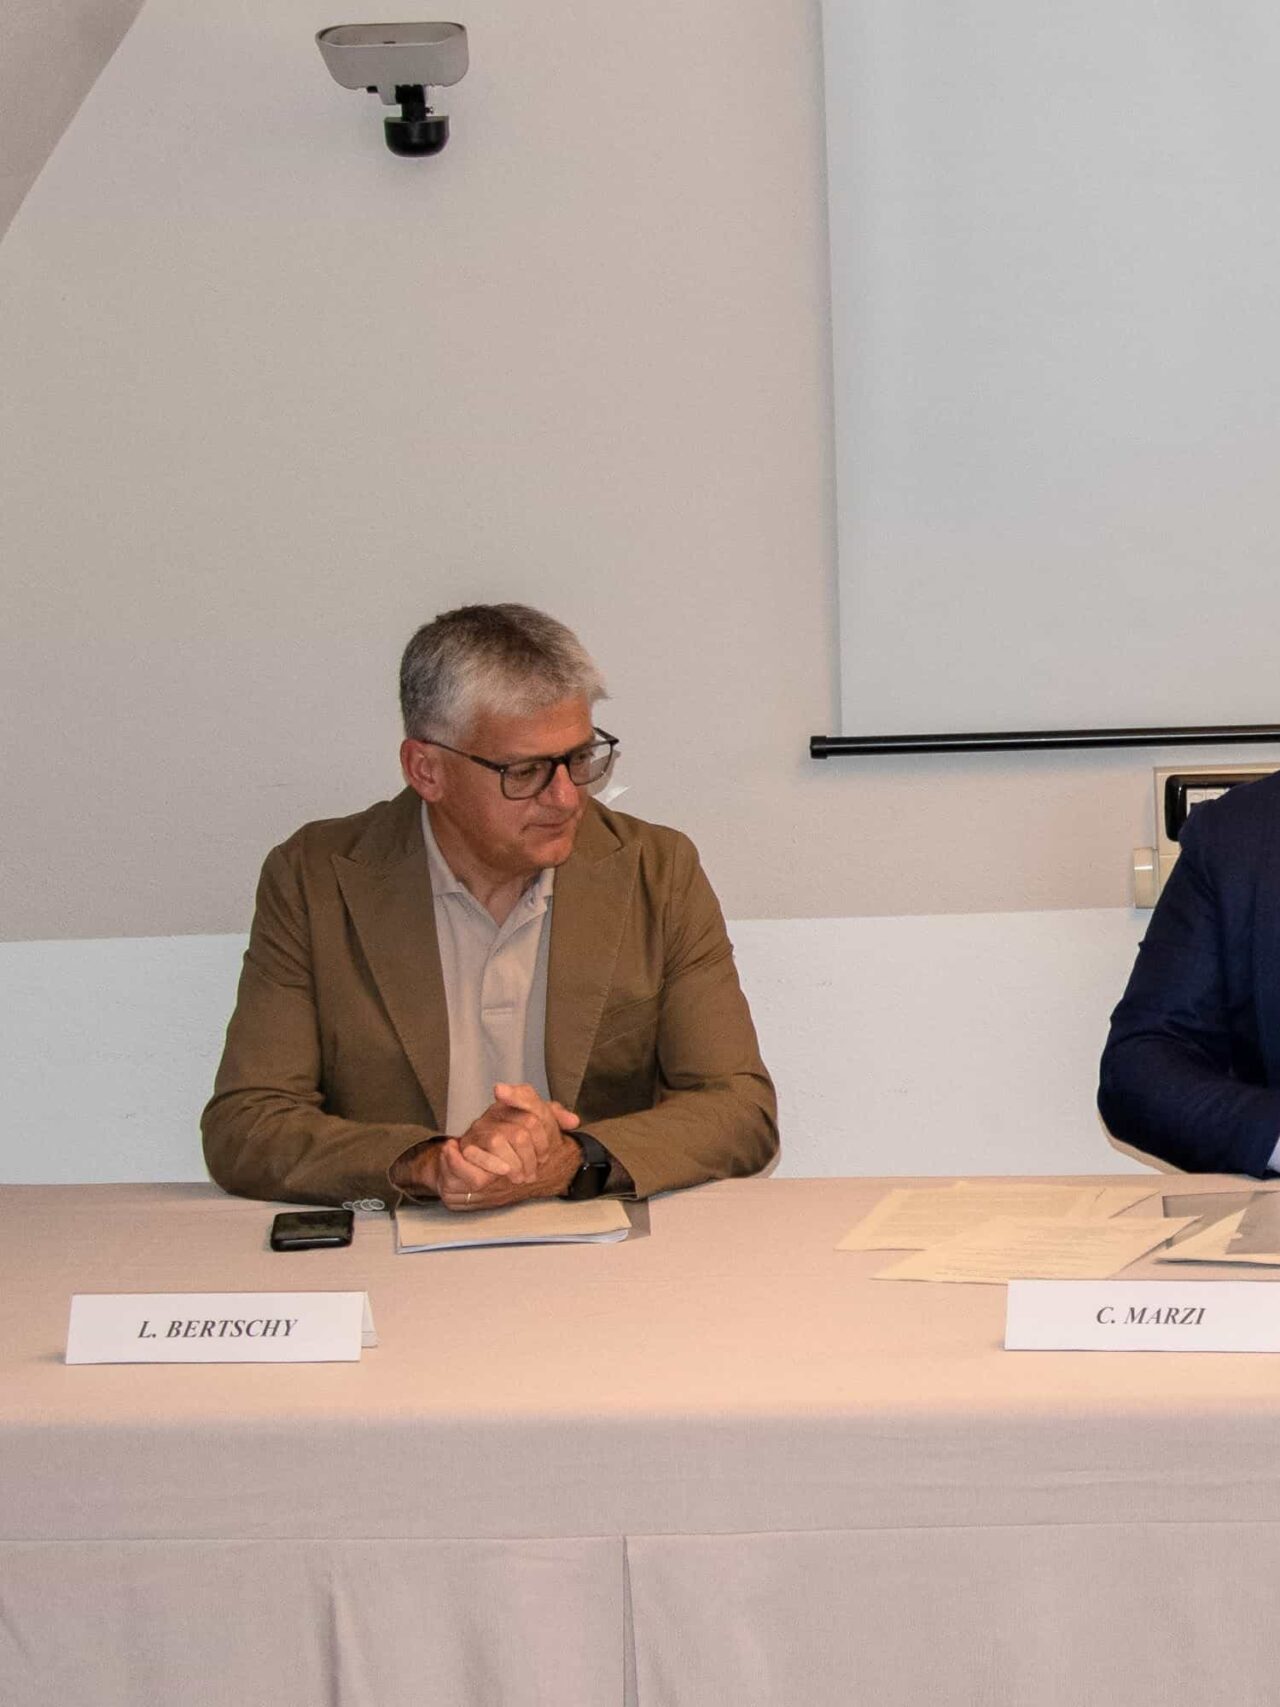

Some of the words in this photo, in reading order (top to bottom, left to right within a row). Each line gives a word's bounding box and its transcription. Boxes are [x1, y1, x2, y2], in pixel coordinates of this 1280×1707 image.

[1096, 1306, 1116, 1325] C.
[1124, 1306, 1206, 1325] MARZI
[137, 1320, 158, 1339] L.
[165, 1318, 298, 1338] BERTSCHY
